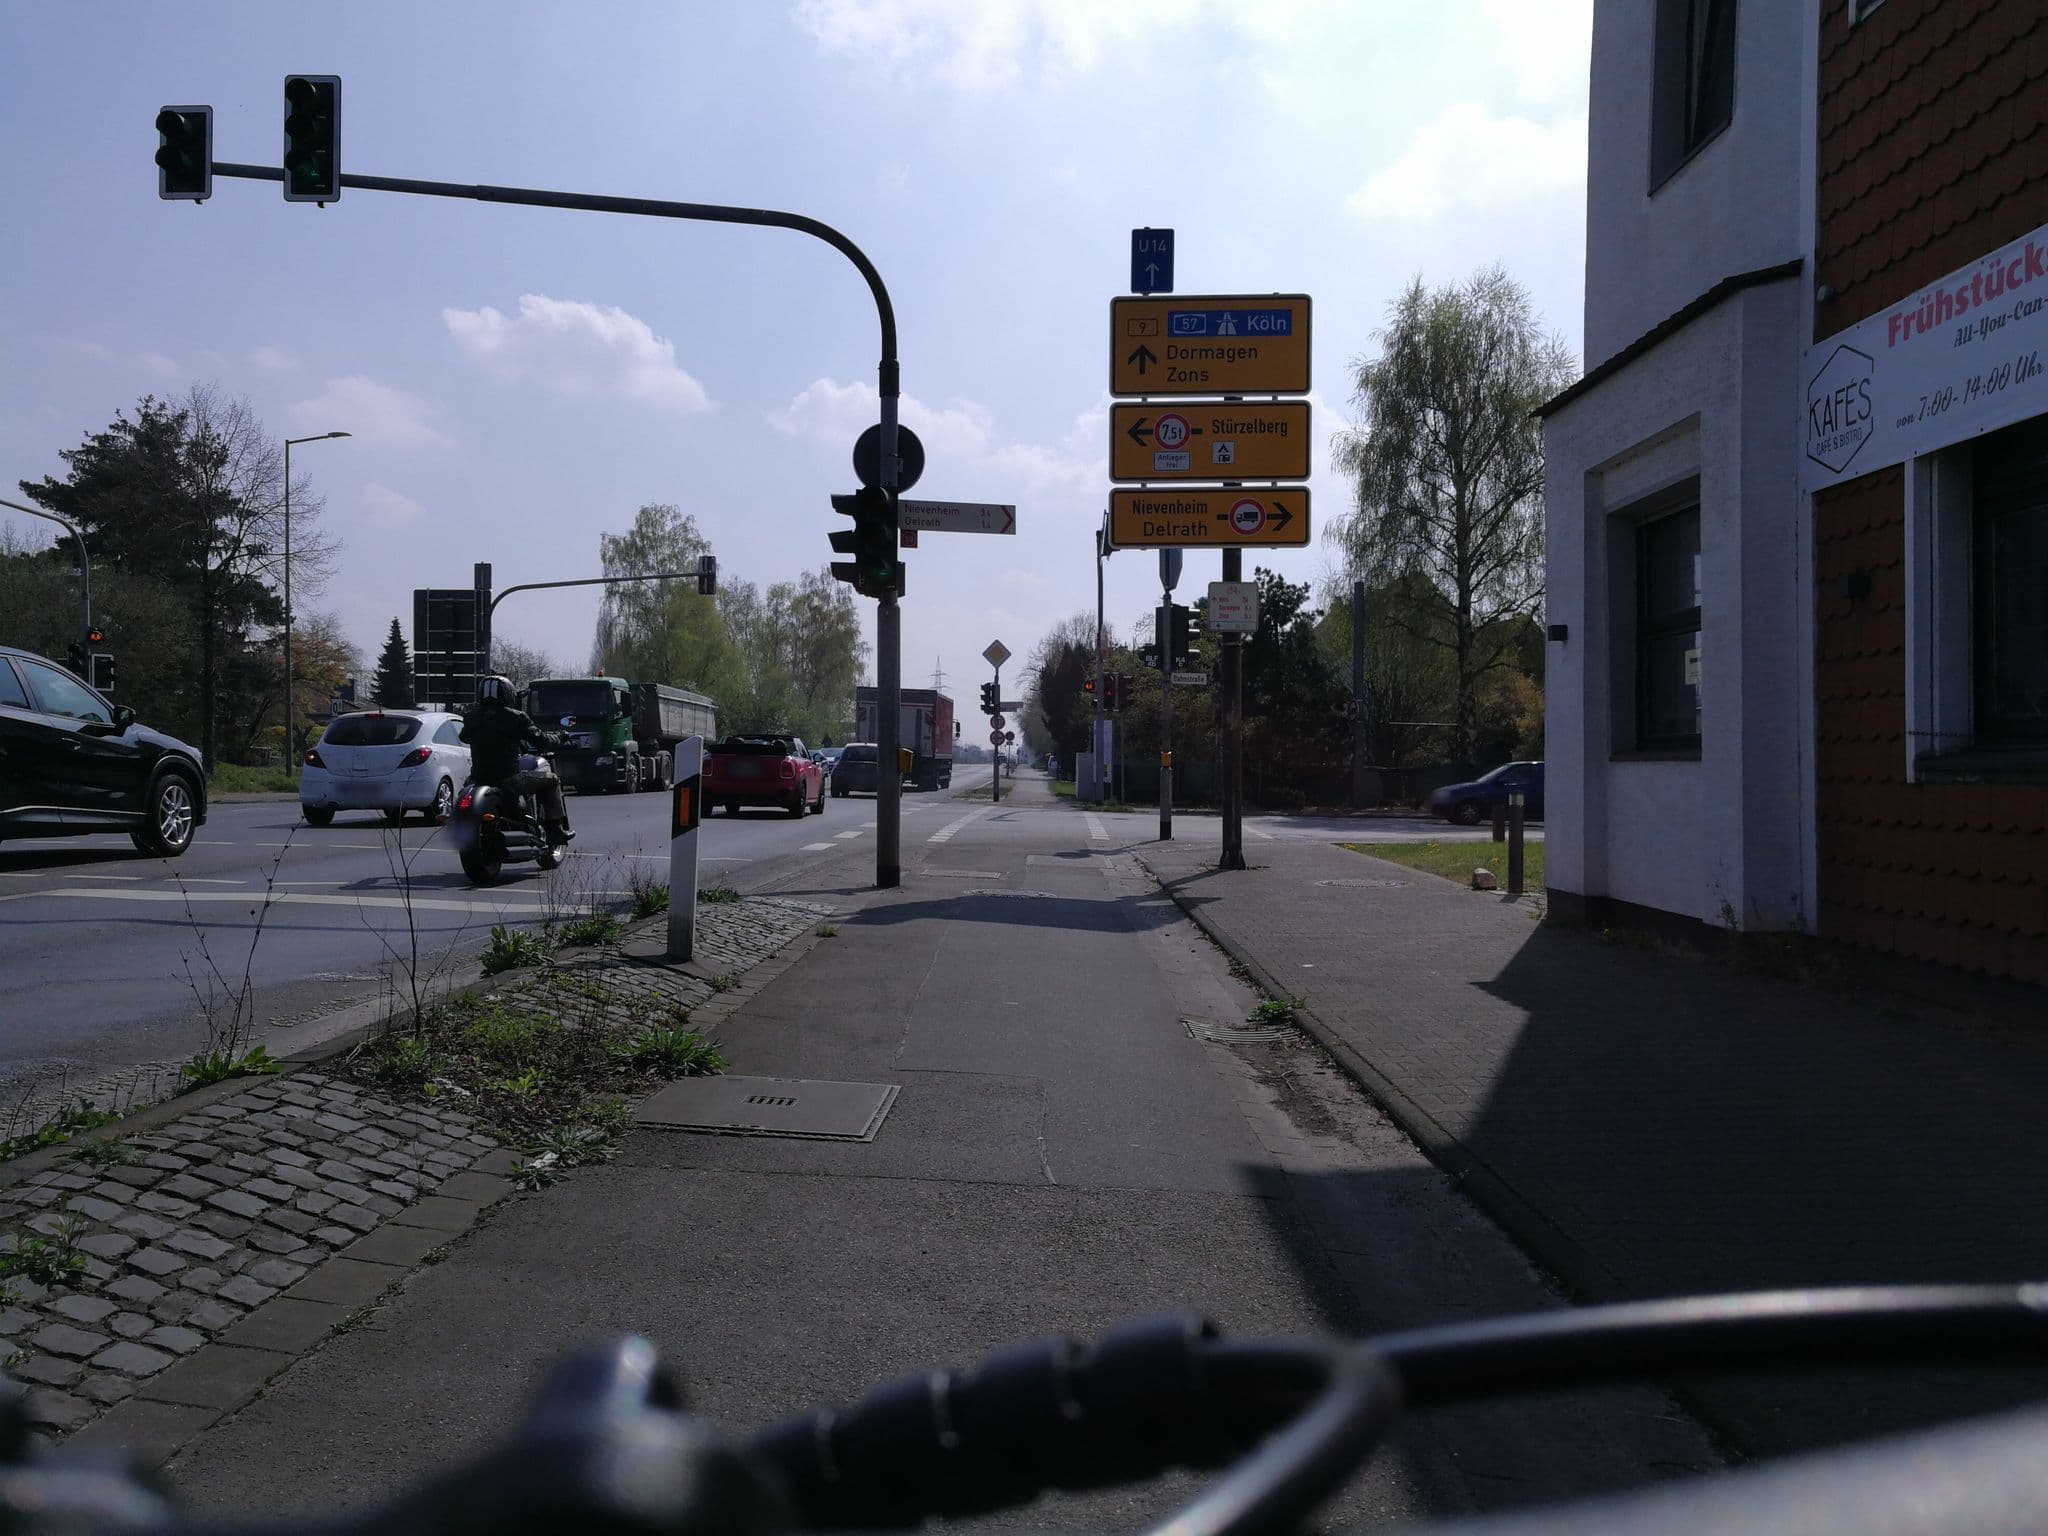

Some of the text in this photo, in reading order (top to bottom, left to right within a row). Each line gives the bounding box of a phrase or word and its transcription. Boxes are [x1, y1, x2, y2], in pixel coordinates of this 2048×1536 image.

[1887, 241, 2048, 348] Frühstück
[1139, 322, 1146, 334] 9
[1182, 314, 1287, 331] 57 Köln
[1167, 345, 1258, 363] Dormagen
[1167, 367, 1209, 382] Zons
[1896, 413, 1915, 428] von
[2015, 350, 2045, 385] Uhr
[1808, 377, 1872, 441] KAFÉS
[1212, 418, 1288, 437] Stürzelberg
[1816, 437, 1831, 455] CAFÉ
[1840, 429, 1862, 447] BISTRO
[1158, 454, 1186, 462] Anlieger
[904, 504, 960, 516] Nievenheim
[1132, 500, 1208, 515] Nievenheim
[904, 516, 941, 528] Delrath
[1143, 521, 1208, 537] Delrath
